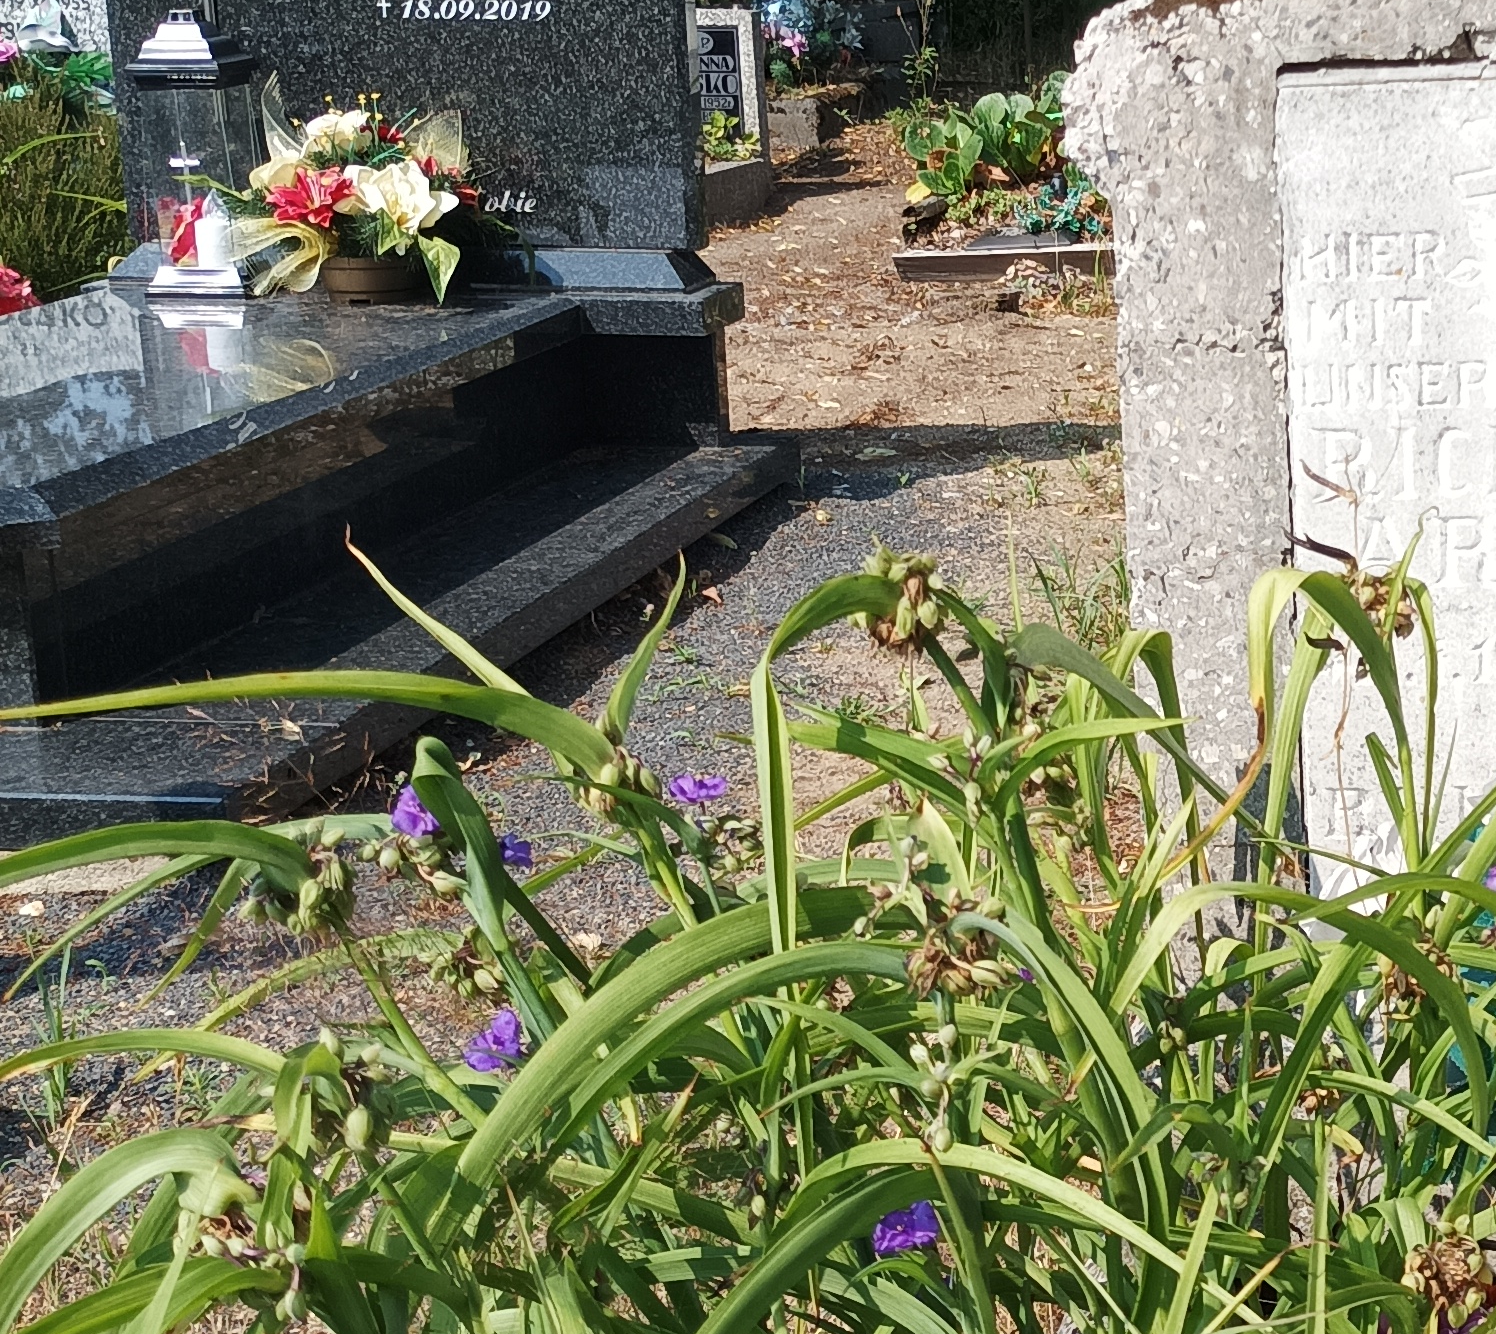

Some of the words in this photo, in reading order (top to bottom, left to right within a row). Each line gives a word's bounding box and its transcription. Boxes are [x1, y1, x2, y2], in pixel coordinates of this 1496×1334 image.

[478, 187, 537, 213] obie
[1299, 231, 1447, 283] HIER
[1304, 295, 1434, 347] MIT
[1300, 360, 1496, 412] UNSER
